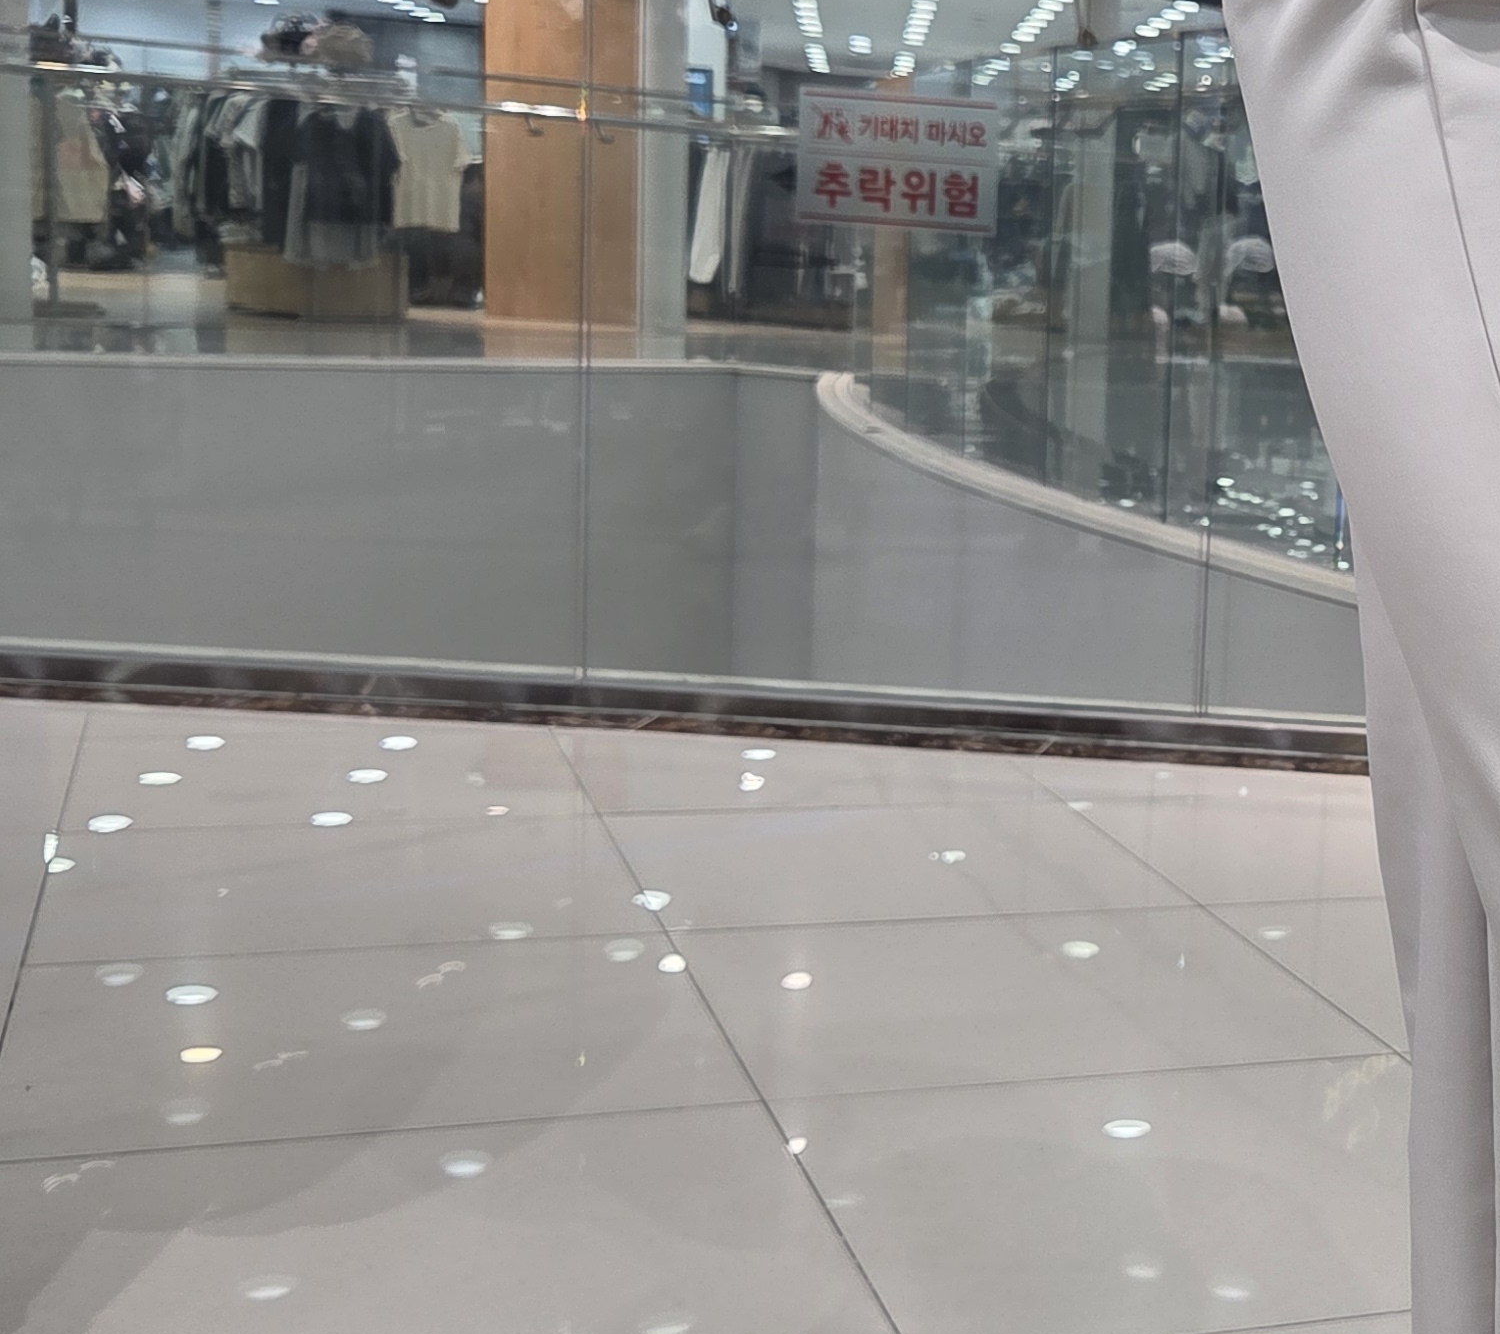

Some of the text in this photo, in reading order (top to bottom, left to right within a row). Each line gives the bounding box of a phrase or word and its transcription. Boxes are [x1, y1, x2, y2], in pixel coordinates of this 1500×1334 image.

[858, 113, 987, 148] 기대지 마시오
[815, 161, 978, 219] 추락위험
